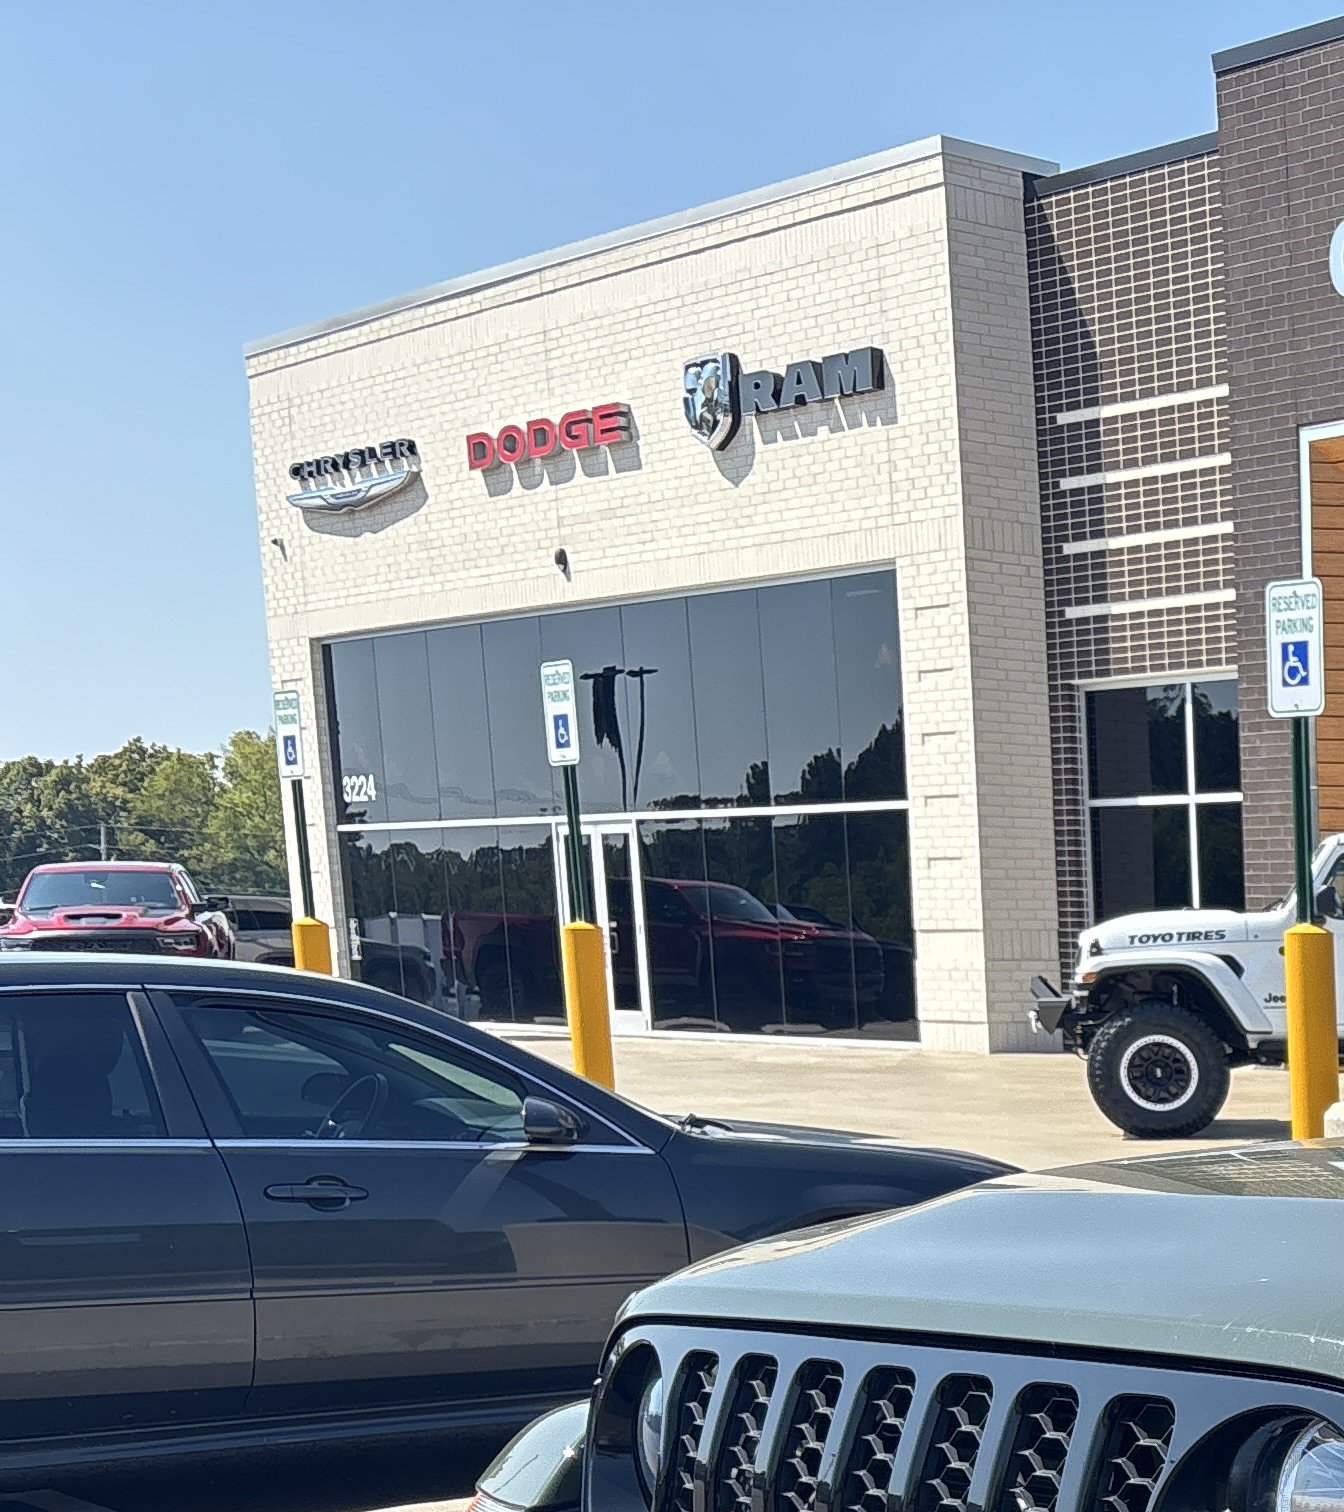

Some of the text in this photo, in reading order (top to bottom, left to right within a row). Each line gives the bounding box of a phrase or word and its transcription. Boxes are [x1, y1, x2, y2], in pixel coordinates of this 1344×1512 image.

[740, 346, 878, 416] RAM
[466, 402, 627, 471] DODGE
[289, 438, 414, 480] CHRYSLER
[1272, 594, 1318, 612] RESERVED
[1275, 616, 1314, 636] PARKING
[342, 774, 376, 803] 3224
[1128, 929, 1226, 945] TOYO TIRES
[1264, 992, 1287, 1003] Jee
